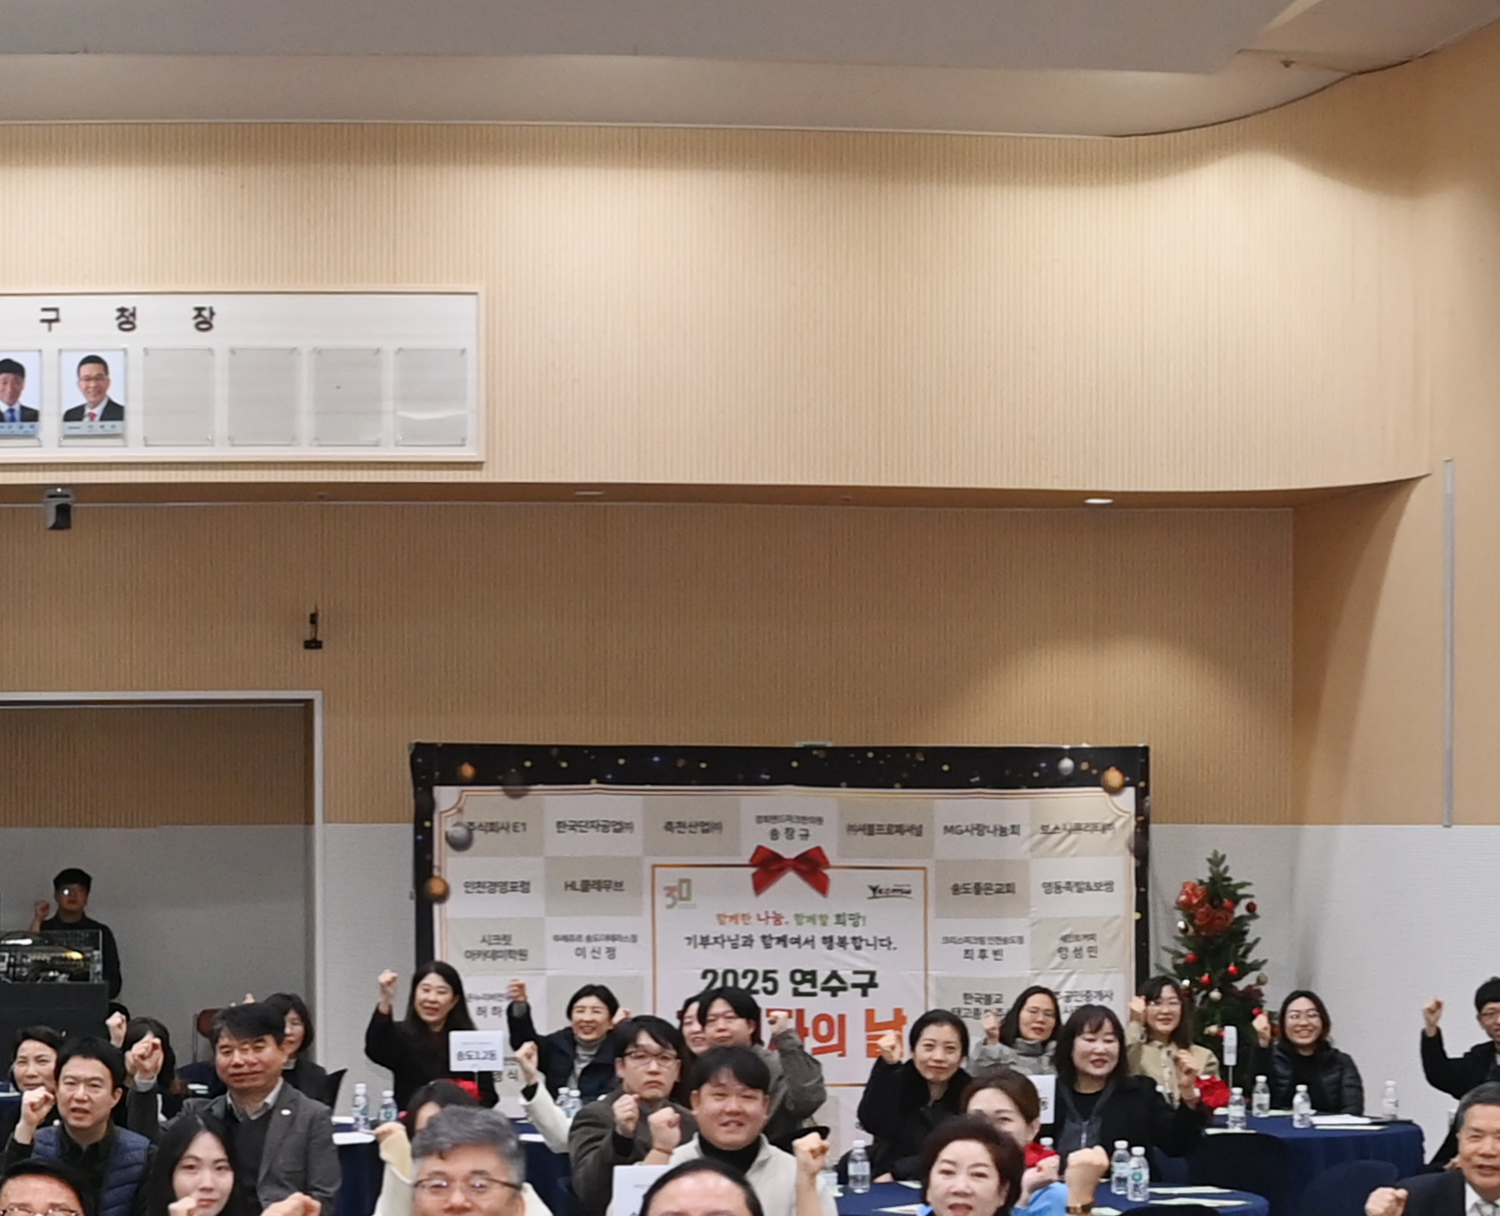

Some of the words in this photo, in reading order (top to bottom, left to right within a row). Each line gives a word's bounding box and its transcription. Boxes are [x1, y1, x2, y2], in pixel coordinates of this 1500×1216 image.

[39, 307, 61, 332] 구
[115, 306, 137, 332] 청
[192, 306, 216, 332] 장
[684, 934, 755, 949] 기부자님과
[760, 934, 817, 950] 함께여서
[821, 935, 897, 951] 행복합니다.
[700, 968, 779, 996] 2025
[789, 968, 879, 998] 연수구
